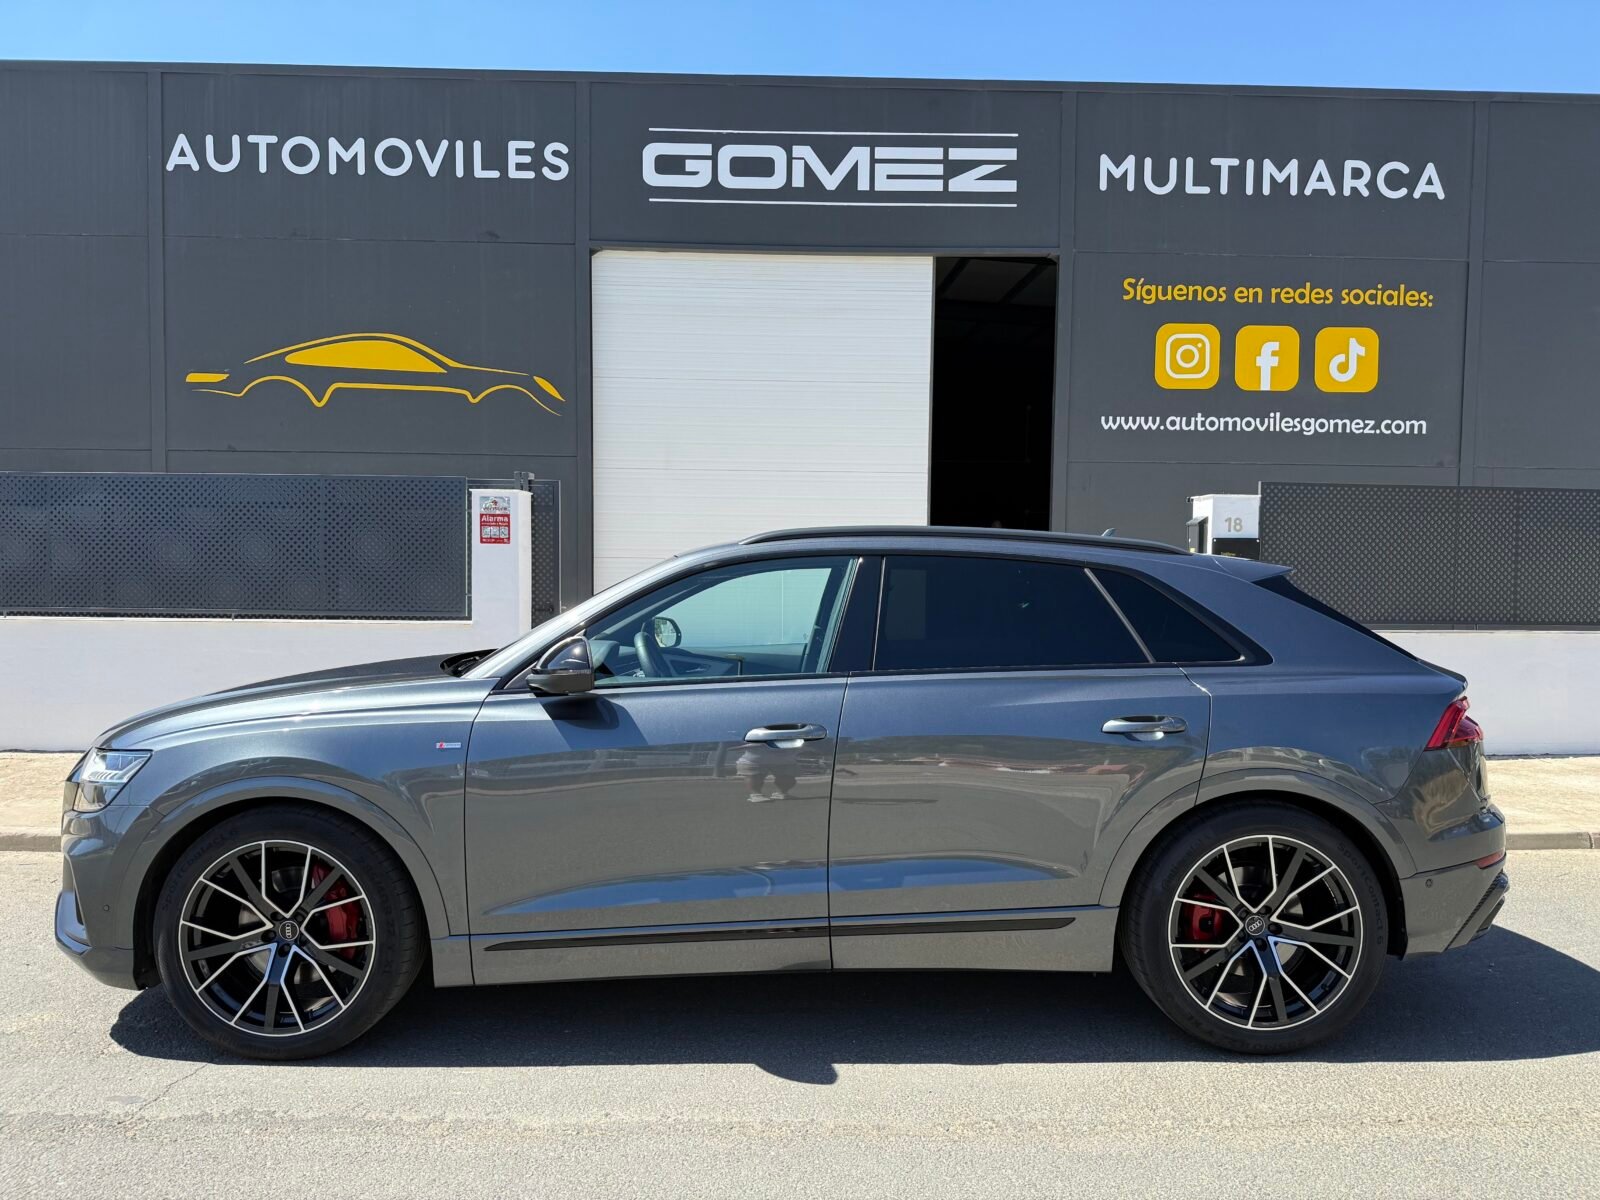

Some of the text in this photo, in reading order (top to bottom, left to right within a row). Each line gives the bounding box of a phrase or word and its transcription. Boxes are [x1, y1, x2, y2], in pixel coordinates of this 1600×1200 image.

[165, 133, 570, 181] AUTOMOVILES
[642, 142, 1018, 193] GOMEZ
[1099, 153, 1446, 200] MULTIMARCA
[1122, 277, 1434, 307] Síguenos en redes sociales:
[1100, 411, 1427, 436] www.automovilesgomez.com
[481, 514, 509, 522] Alarma
[1224, 516, 1243, 533] 18
